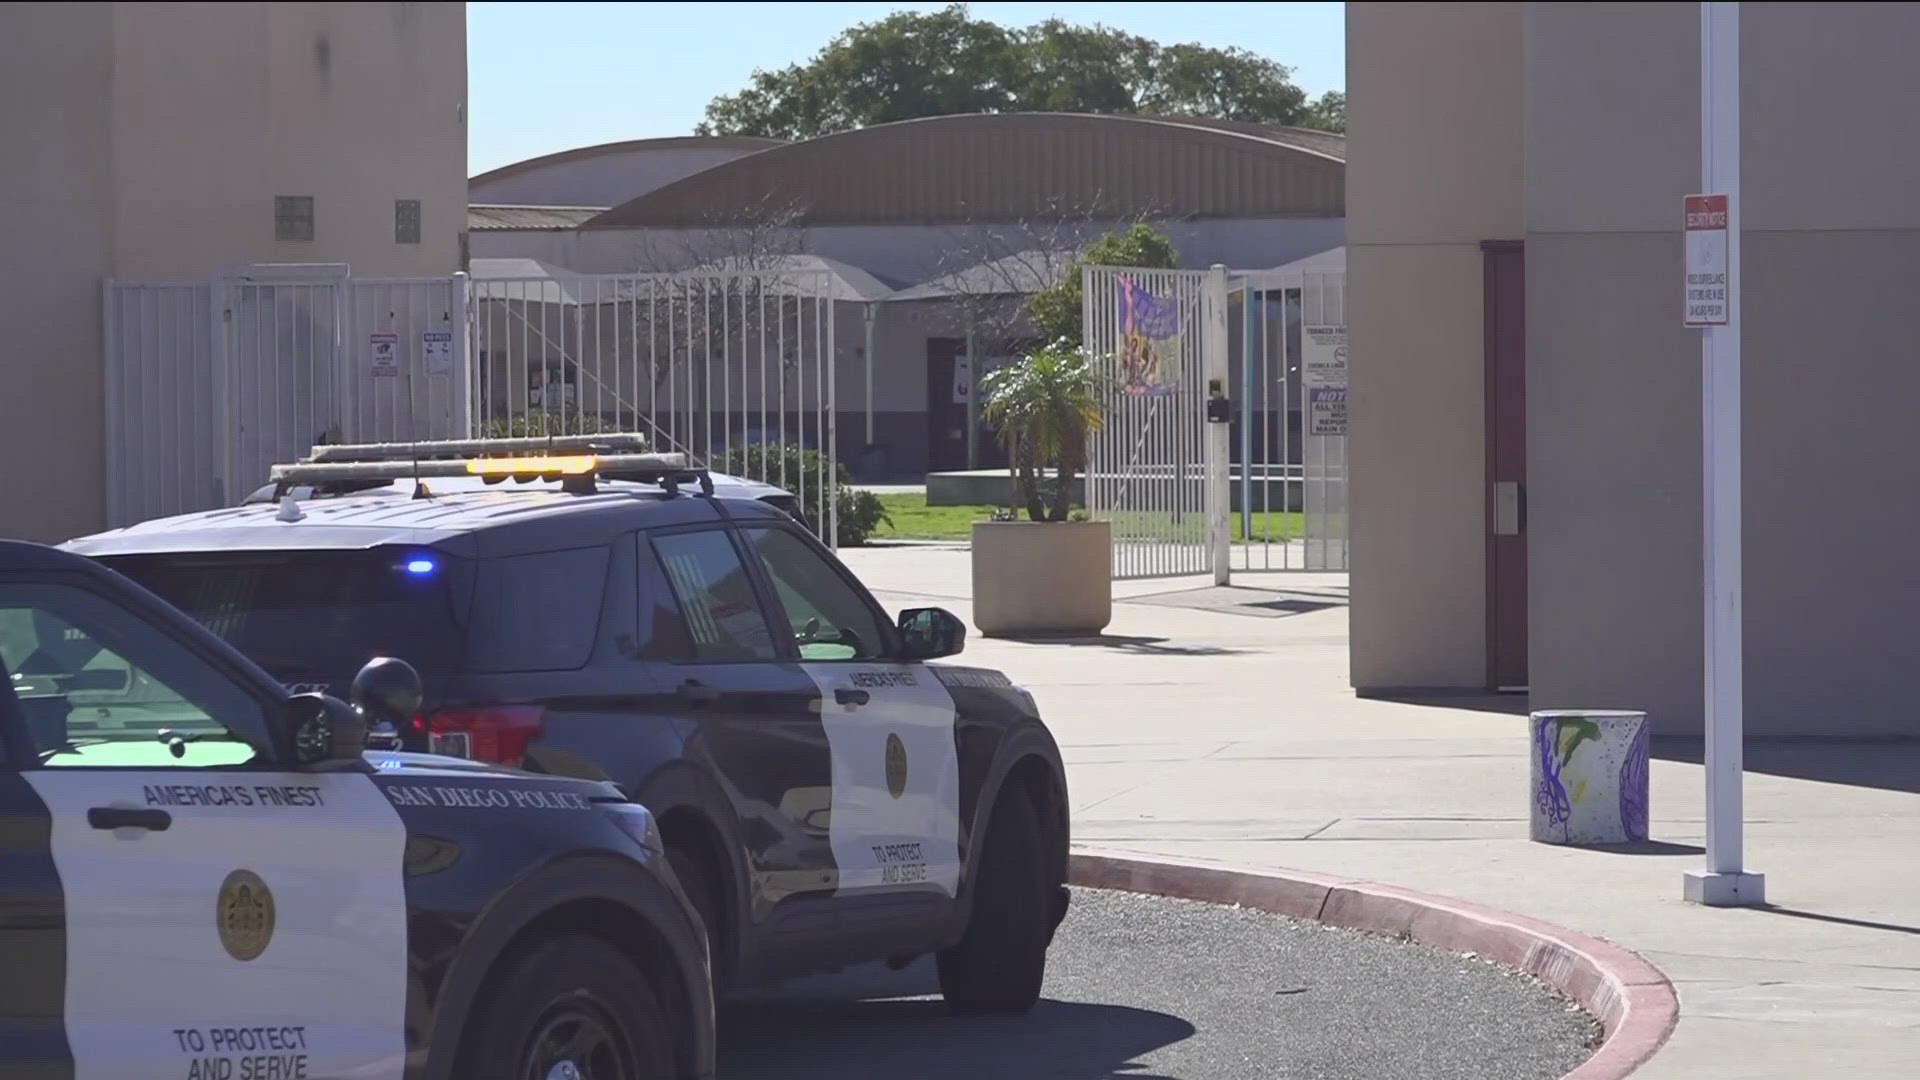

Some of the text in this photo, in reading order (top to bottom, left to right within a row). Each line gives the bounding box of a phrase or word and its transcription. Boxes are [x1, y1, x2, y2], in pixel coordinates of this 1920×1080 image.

[143, 785, 324, 807] AMERICA'S FINEST
[387, 785, 591, 810] SAN DIEGO POLICE
[872, 843, 922, 863] TO PROTECT
[173, 1026, 306, 1052] TO PROTECT
[187, 1055, 307, 1080] AND SERVE
